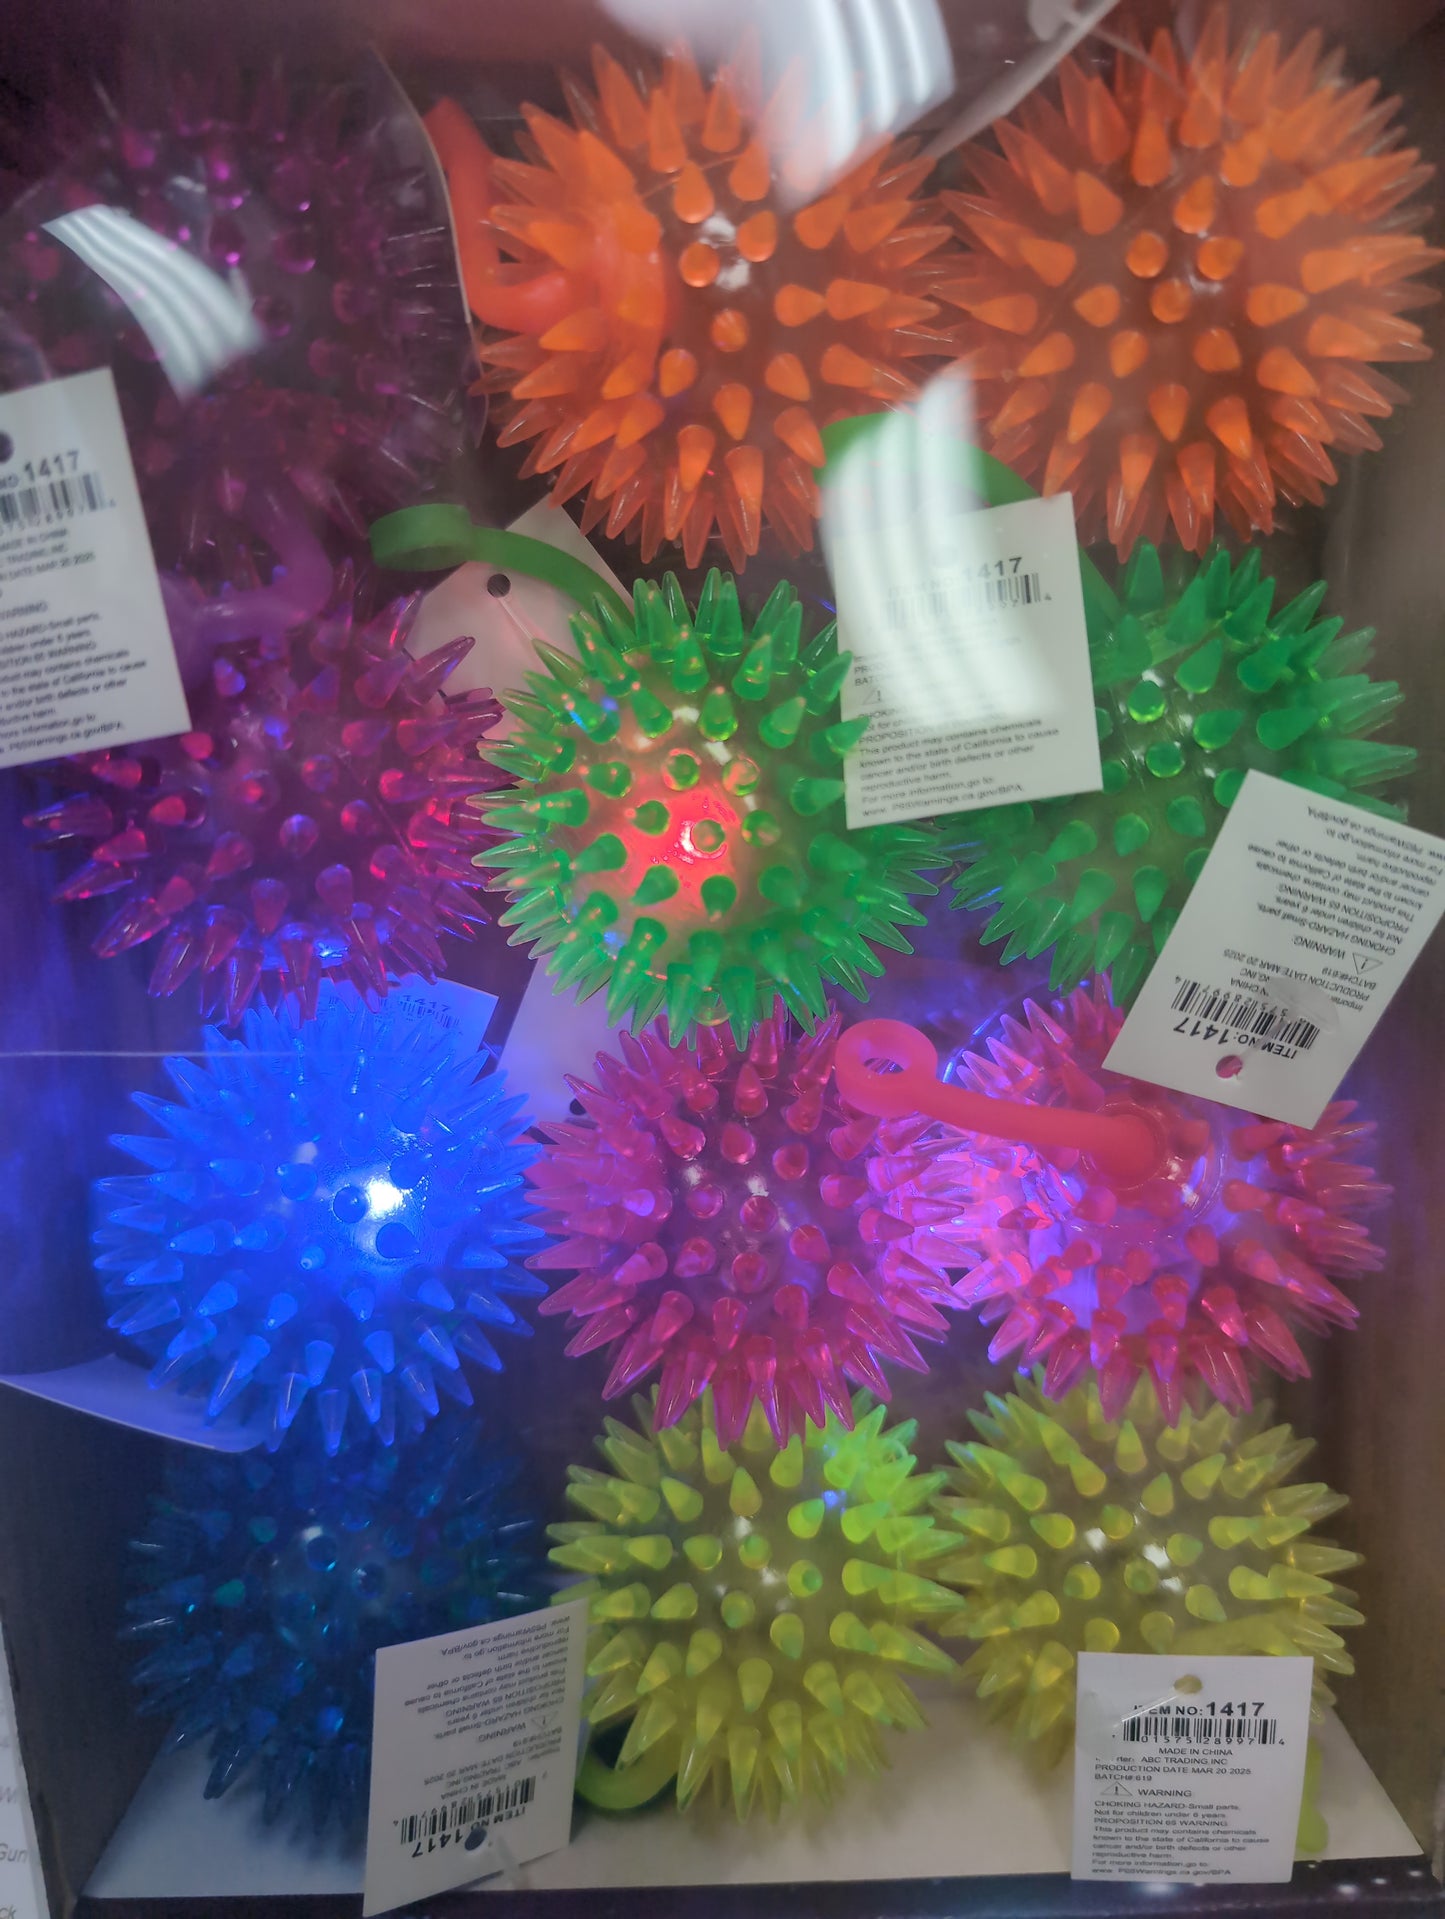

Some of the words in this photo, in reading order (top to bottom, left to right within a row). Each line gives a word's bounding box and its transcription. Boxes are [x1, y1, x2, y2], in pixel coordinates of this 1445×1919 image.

[23, 448, 82, 482] 1417
[1339, 903, 1410, 933] PROPOSITION
[1348, 934, 1397, 956] CHOKING
[1257, 959, 1282, 973] MAR
[1280, 966, 1308, 982] DATE
[1306, 975, 1370, 1002] PRODUCTION
[1172, 1014, 1233, 1046] 1417
[1260, 1040, 1297, 1059] ITEM
[1205, 1701, 1264, 1716] 1417
[1095, 1764, 1160, 1772] PRODUCTION
[493, 1805, 525, 1824] ITEM
[1114, 1826, 1147, 1834] product
[411, 1827, 462, 1858] 1417
